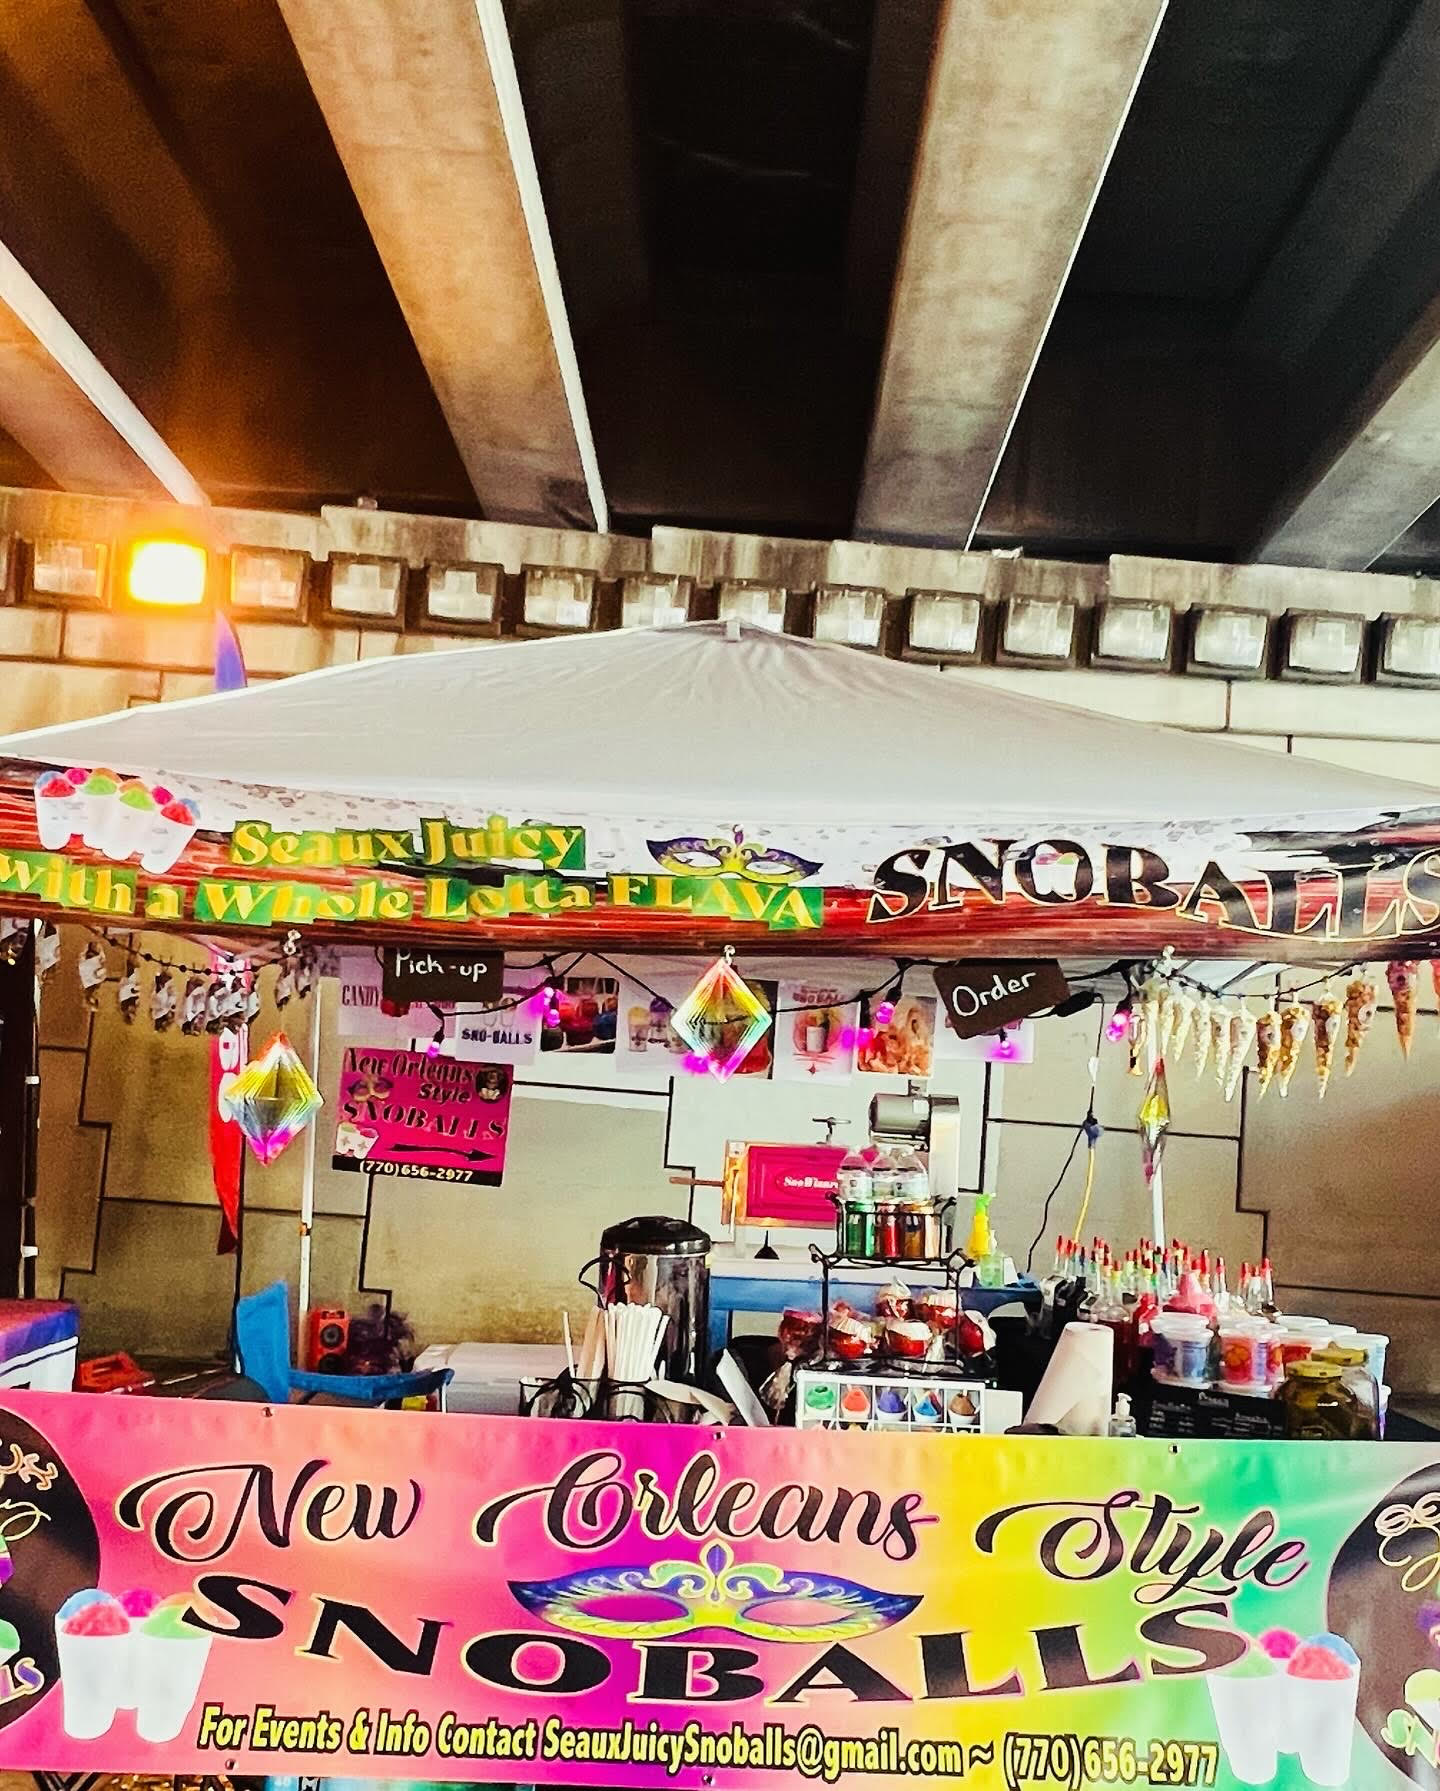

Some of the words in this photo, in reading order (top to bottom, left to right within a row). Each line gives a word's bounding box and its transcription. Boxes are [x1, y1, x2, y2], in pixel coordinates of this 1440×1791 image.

[231, 823, 413, 866] Seaux
[424, 815, 582, 869] Juicy
[145, 885, 180, 919] a
[205, 879, 410, 921] Whole
[428, 876, 592, 920] Lotta
[611, 873, 814, 929] FLAVA
[866, 838, 1440, 942] SNOBALLS
[952, 972, 1036, 1017] Order
[344, 1048, 388, 1075] New
[392, 1054, 474, 1084] Orleans
[340, 1100, 507, 1140] SNOBALLS
[418, 1083, 472, 1105] Style
[360, 1160, 474, 1183] (770)656-2977
[116, 1459, 422, 1563] New
[472, 1451, 939, 1561] Orleans
[976, 1489, 1310, 1604] Style
[181, 1573, 1249, 1704] SNOBALLS
[199, 1703, 250, 1749] For
[249, 1705, 343, 1750] Events
[347, 1708, 371, 1753] &
[374, 1709, 431, 1756] Info
[436, 1711, 537, 1758] Contact
[541, 1715, 963, 1780] SeauxJuicySnoballs@gmail.com
[1003, 1733, 1218, 1788] (770)656-2977
